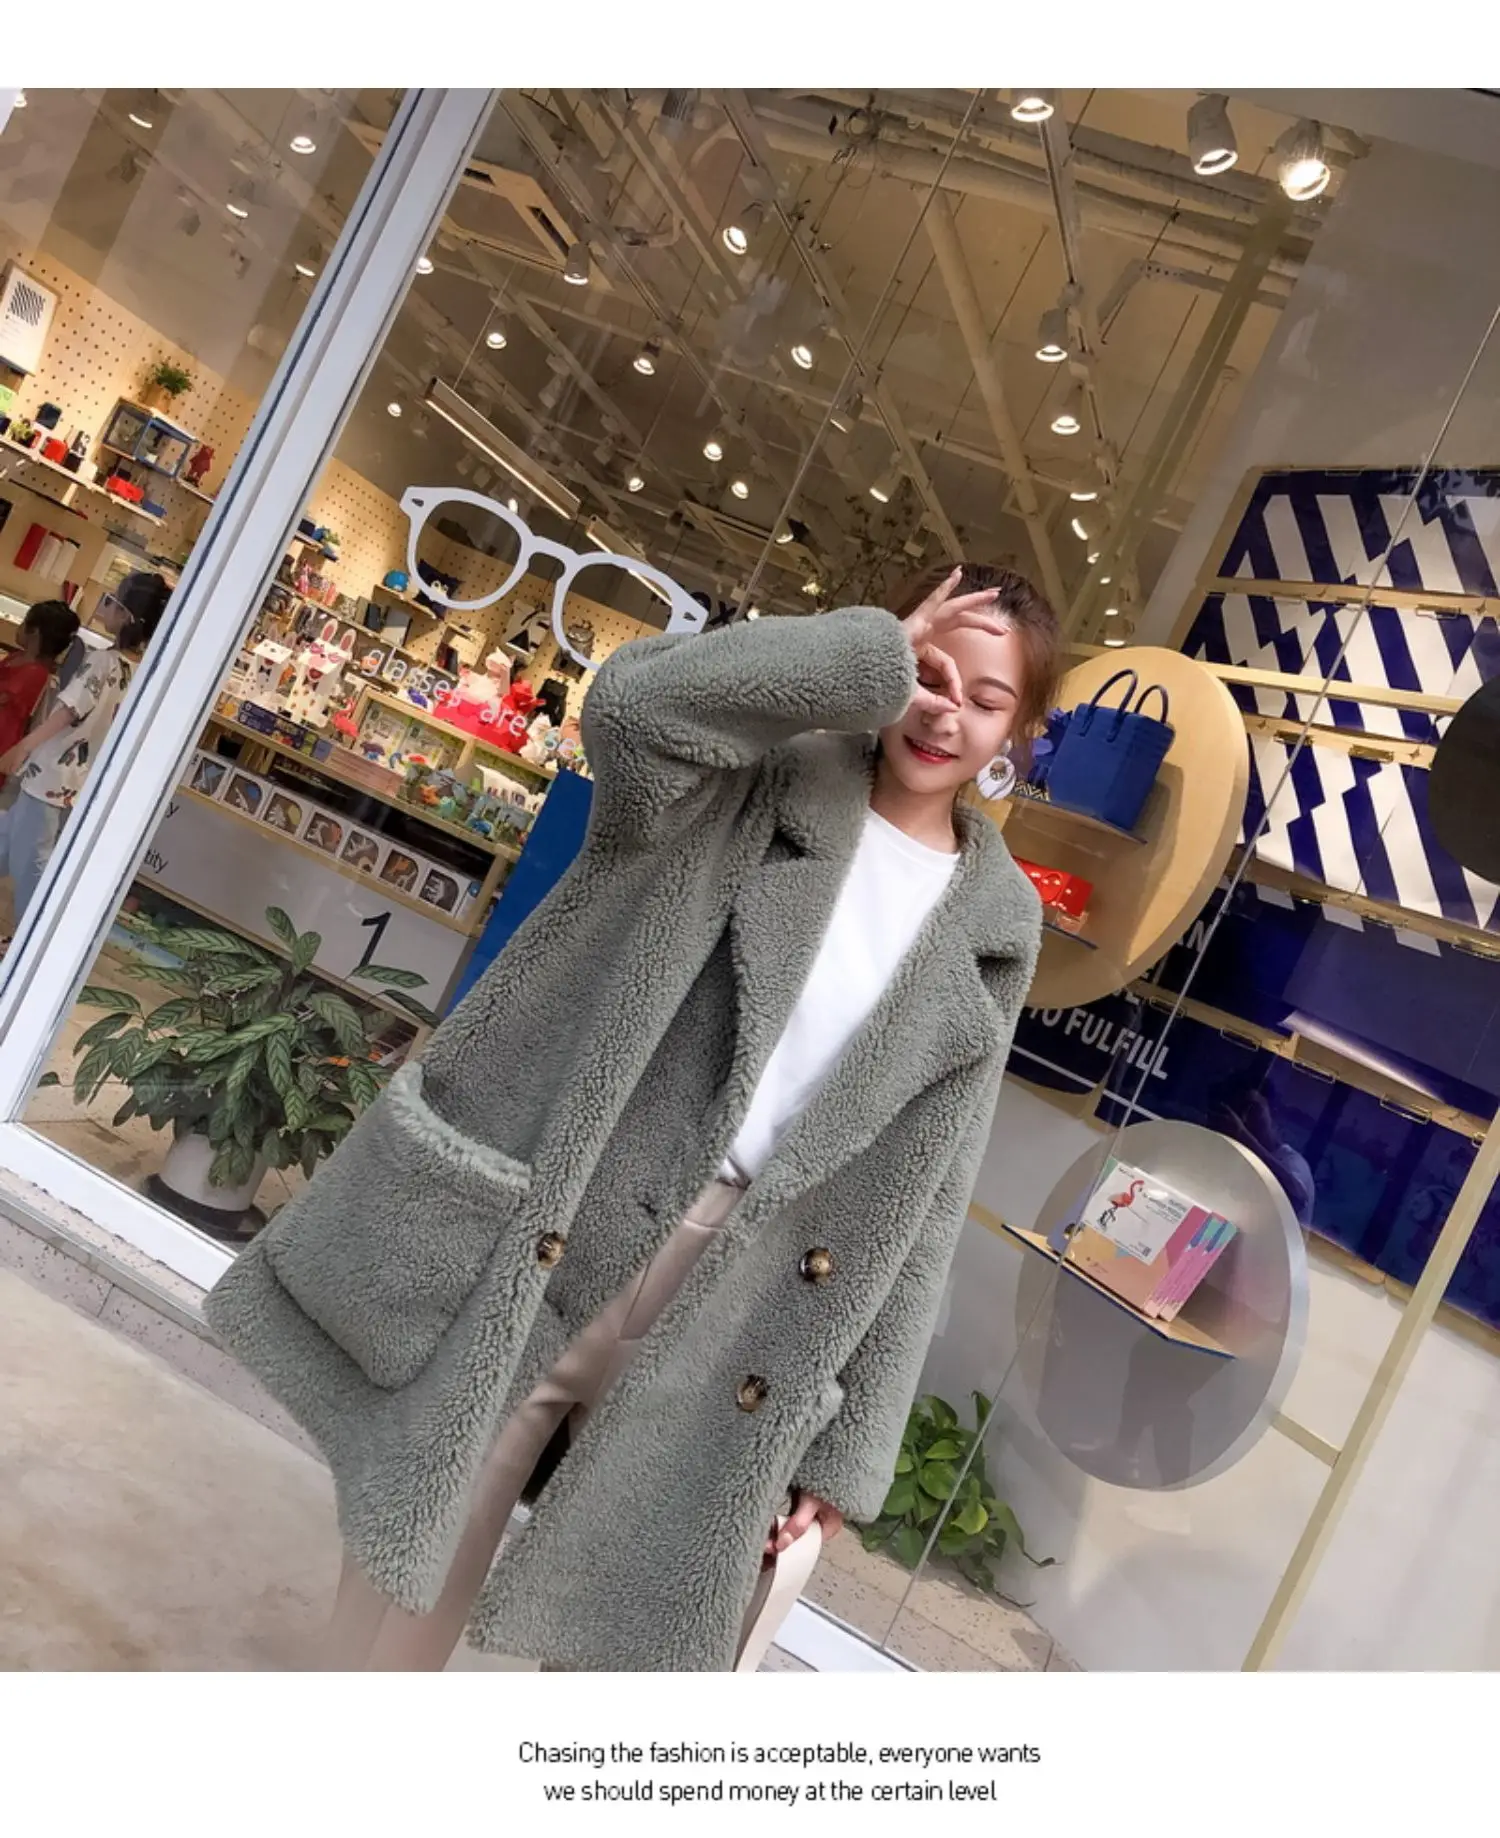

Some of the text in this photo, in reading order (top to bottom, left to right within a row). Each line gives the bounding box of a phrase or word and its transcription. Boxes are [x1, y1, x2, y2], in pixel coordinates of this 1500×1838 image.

[361, 647, 462, 706] glasses
[480, 709, 527, 737] are
[1064, 1008, 1169, 1080] FULFILL
